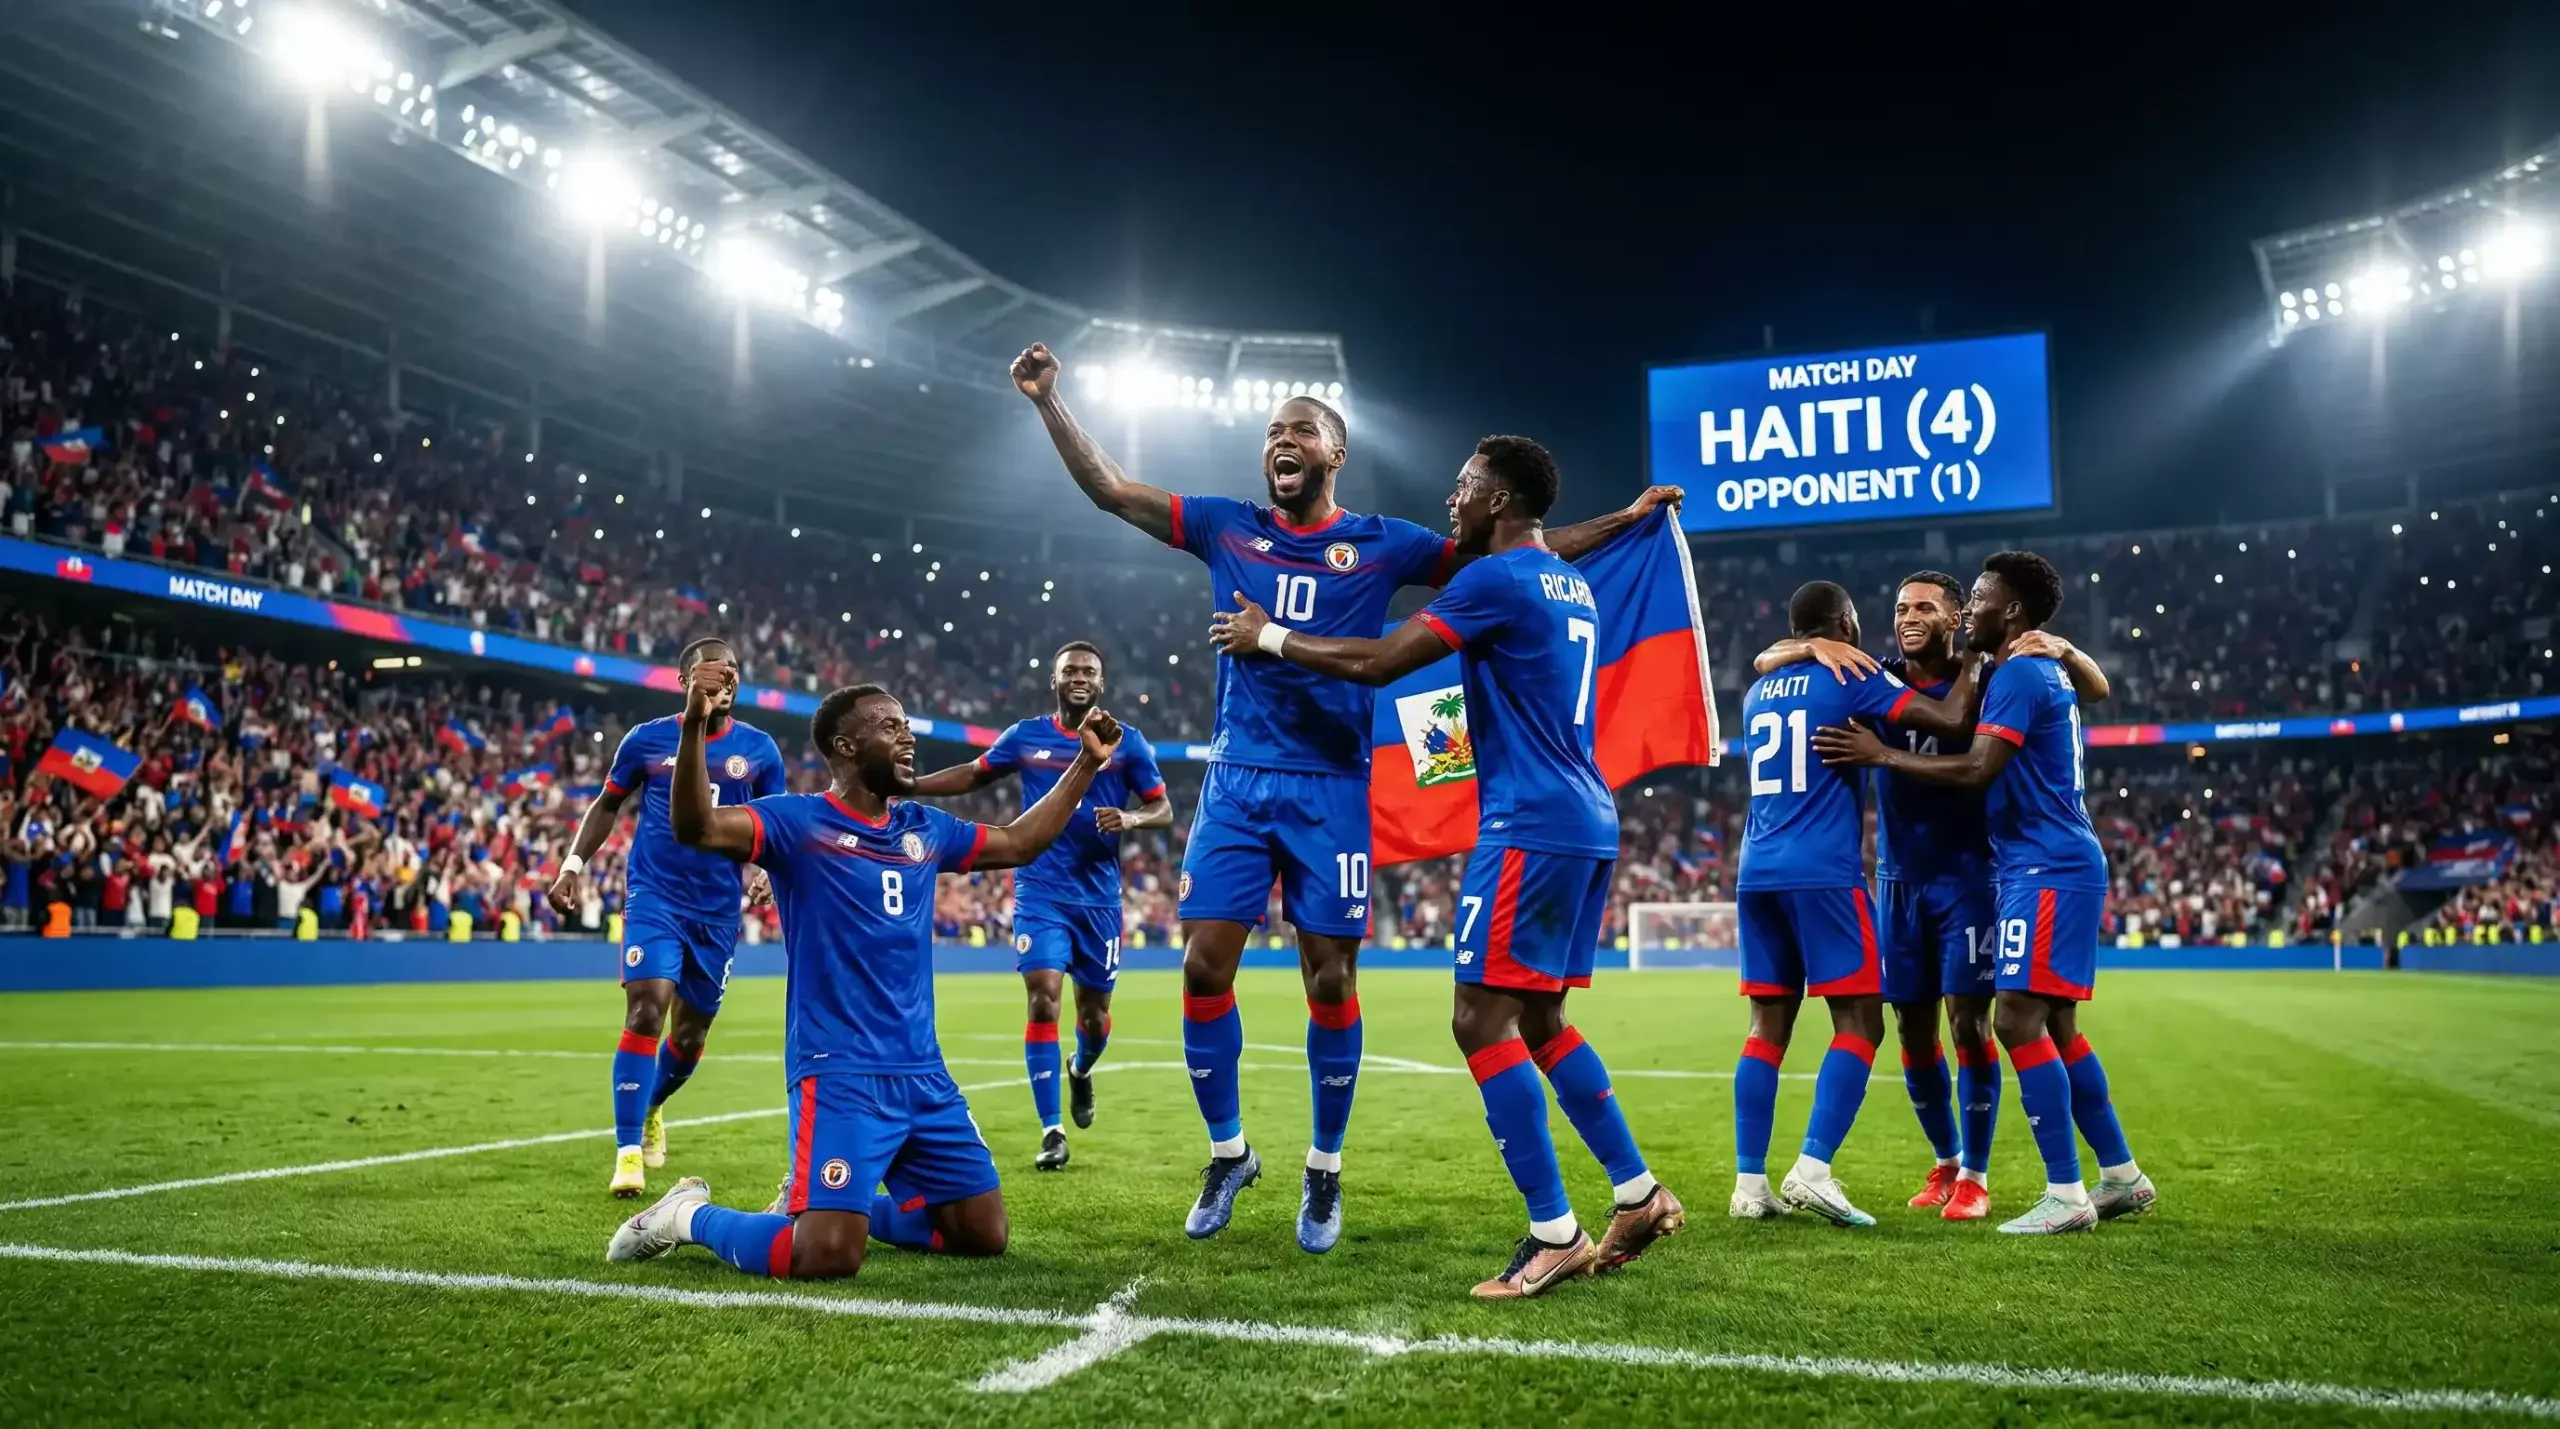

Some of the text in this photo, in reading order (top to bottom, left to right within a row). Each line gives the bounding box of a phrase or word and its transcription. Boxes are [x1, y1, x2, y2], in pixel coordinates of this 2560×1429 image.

[1769, 355, 1917, 390] MATCH DAY
[1700, 383, 1996, 465] HAITI (4)
[1717, 459, 1980, 512] OPPONENT (1)
[169, 576, 263, 611] MATCH DAY
[1275, 574, 1317, 621] 10
[1568, 617, 1595, 725] 7
[1760, 675, 1810, 701] HAITI
[1751, 710, 1807, 796] 21
[881, 870, 904, 916] 8
[1336, 853, 1368, 899] 10
[1461, 896, 1483, 943] 7
[1998, 918, 2027, 959] 19
[1965, 926, 1996, 964] 14
